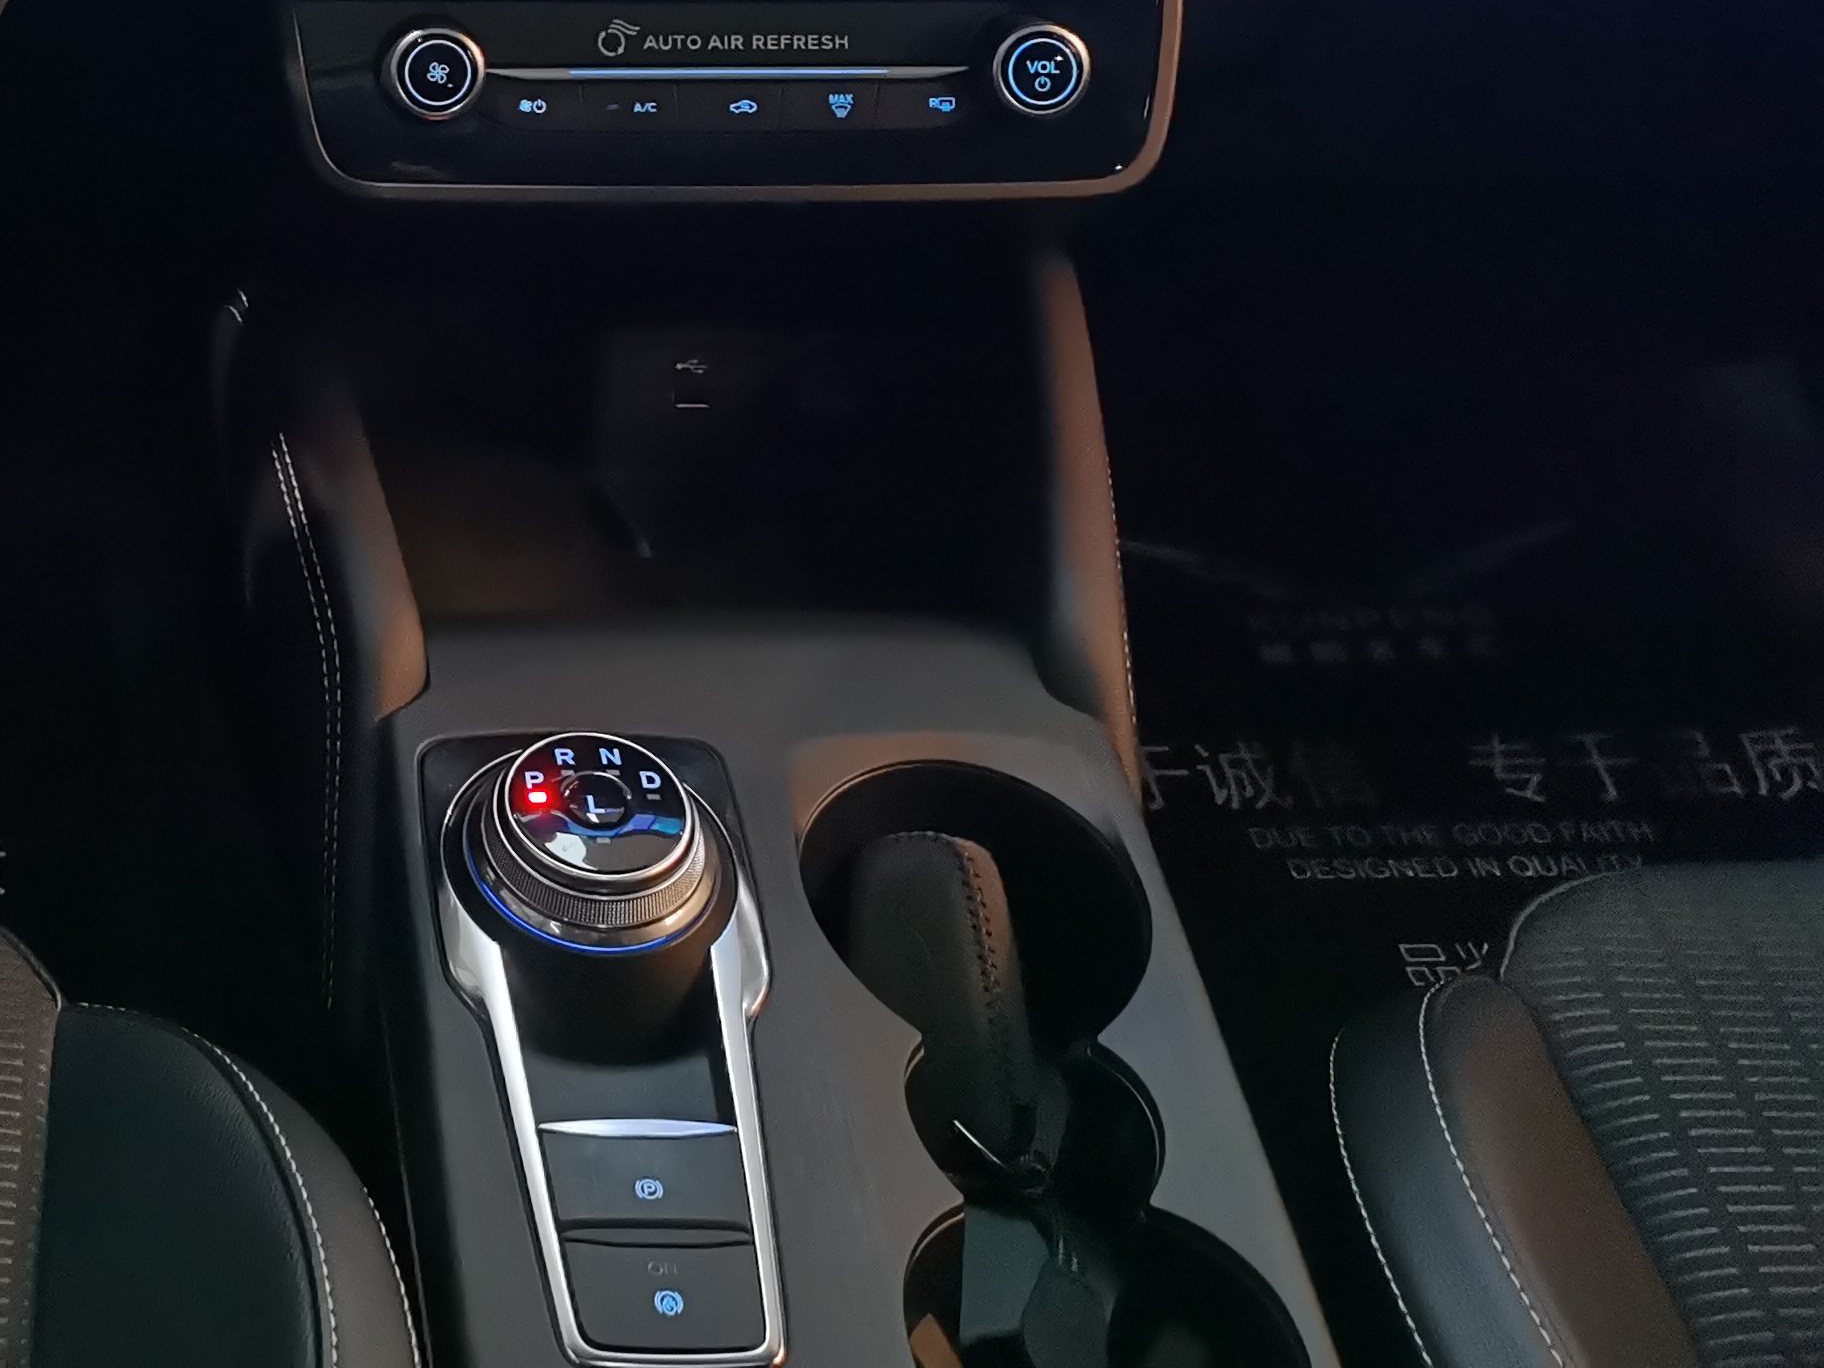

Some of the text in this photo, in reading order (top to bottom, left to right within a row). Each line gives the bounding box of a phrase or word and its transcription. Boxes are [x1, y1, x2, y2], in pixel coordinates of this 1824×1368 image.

[642, 33, 850, 51] AUTO AIR REFRESH
[1025, 59, 1060, 75] VOL
[633, 101, 658, 113] A/C
[828, 93, 854, 105] MAX
[525, 747, 662, 790] P R N D
[586, 794, 607, 815] L
[1248, 825, 1318, 850] DUE
[1329, 824, 1373, 848] TO
[1452, 821, 1552, 847] GOOD
[1288, 855, 1459, 881] DESIGNED
[1468, 855, 1501, 879] IN
